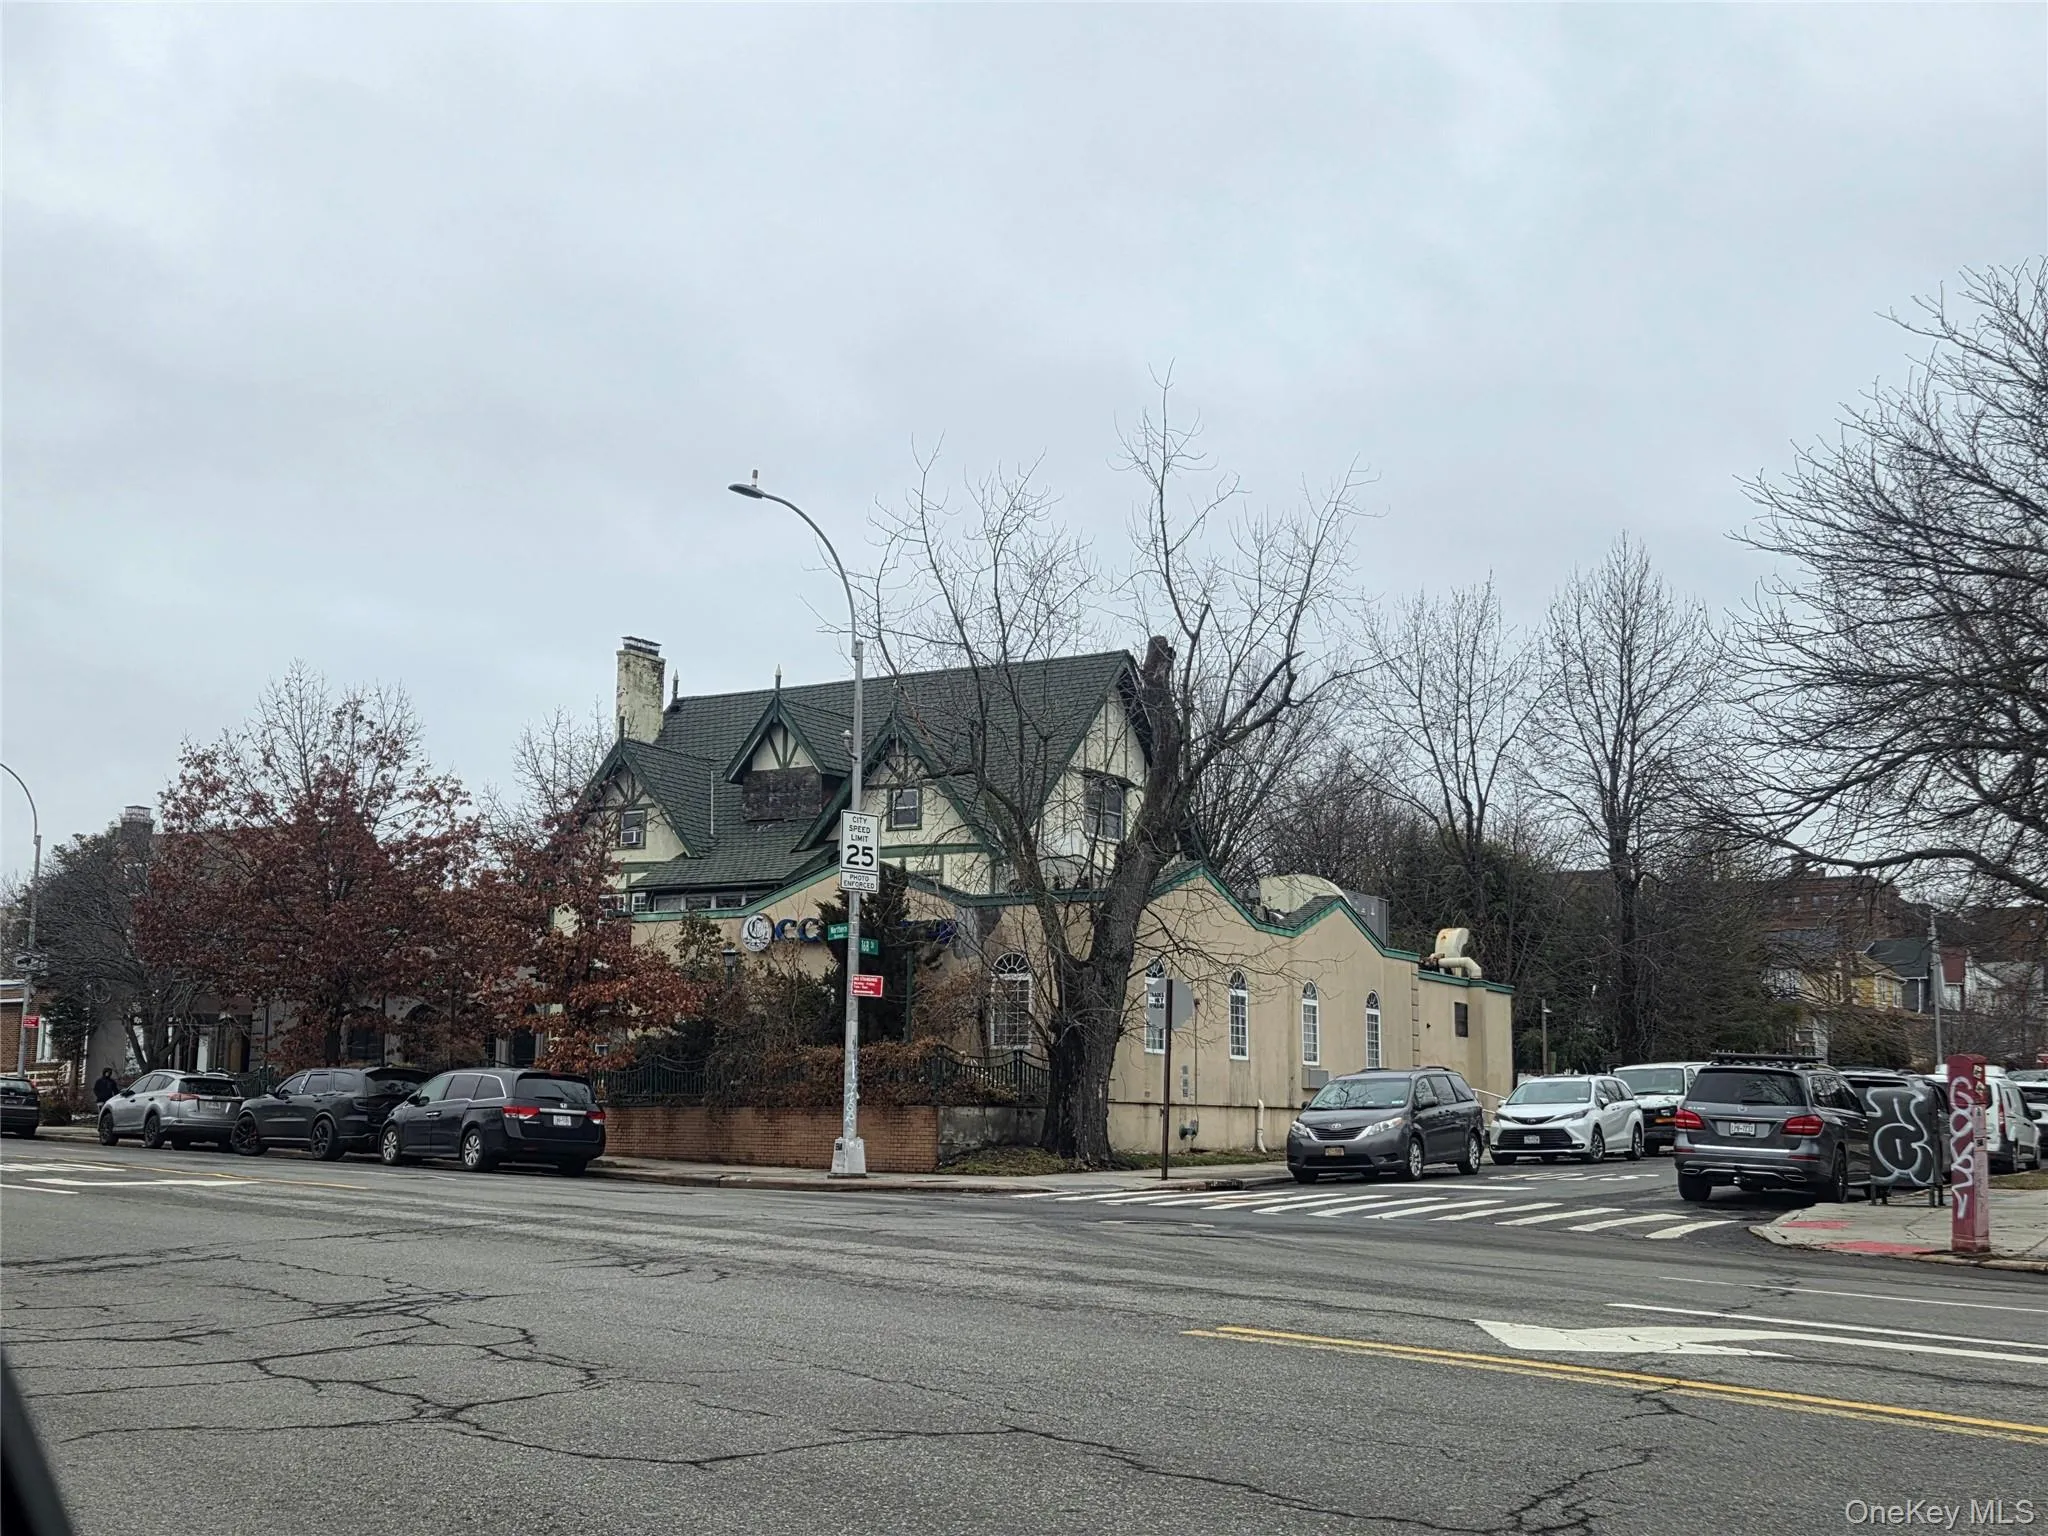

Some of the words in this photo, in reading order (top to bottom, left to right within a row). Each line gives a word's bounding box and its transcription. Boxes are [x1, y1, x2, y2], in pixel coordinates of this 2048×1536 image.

[852, 816, 868, 824] CITY
[848, 825, 871, 834] SPEED
[850, 834, 869, 842] LIMIT
[846, 844, 874, 867] 25
[849, 874, 870, 882] PHOTO
[843, 880, 875, 889] ENFORCED
